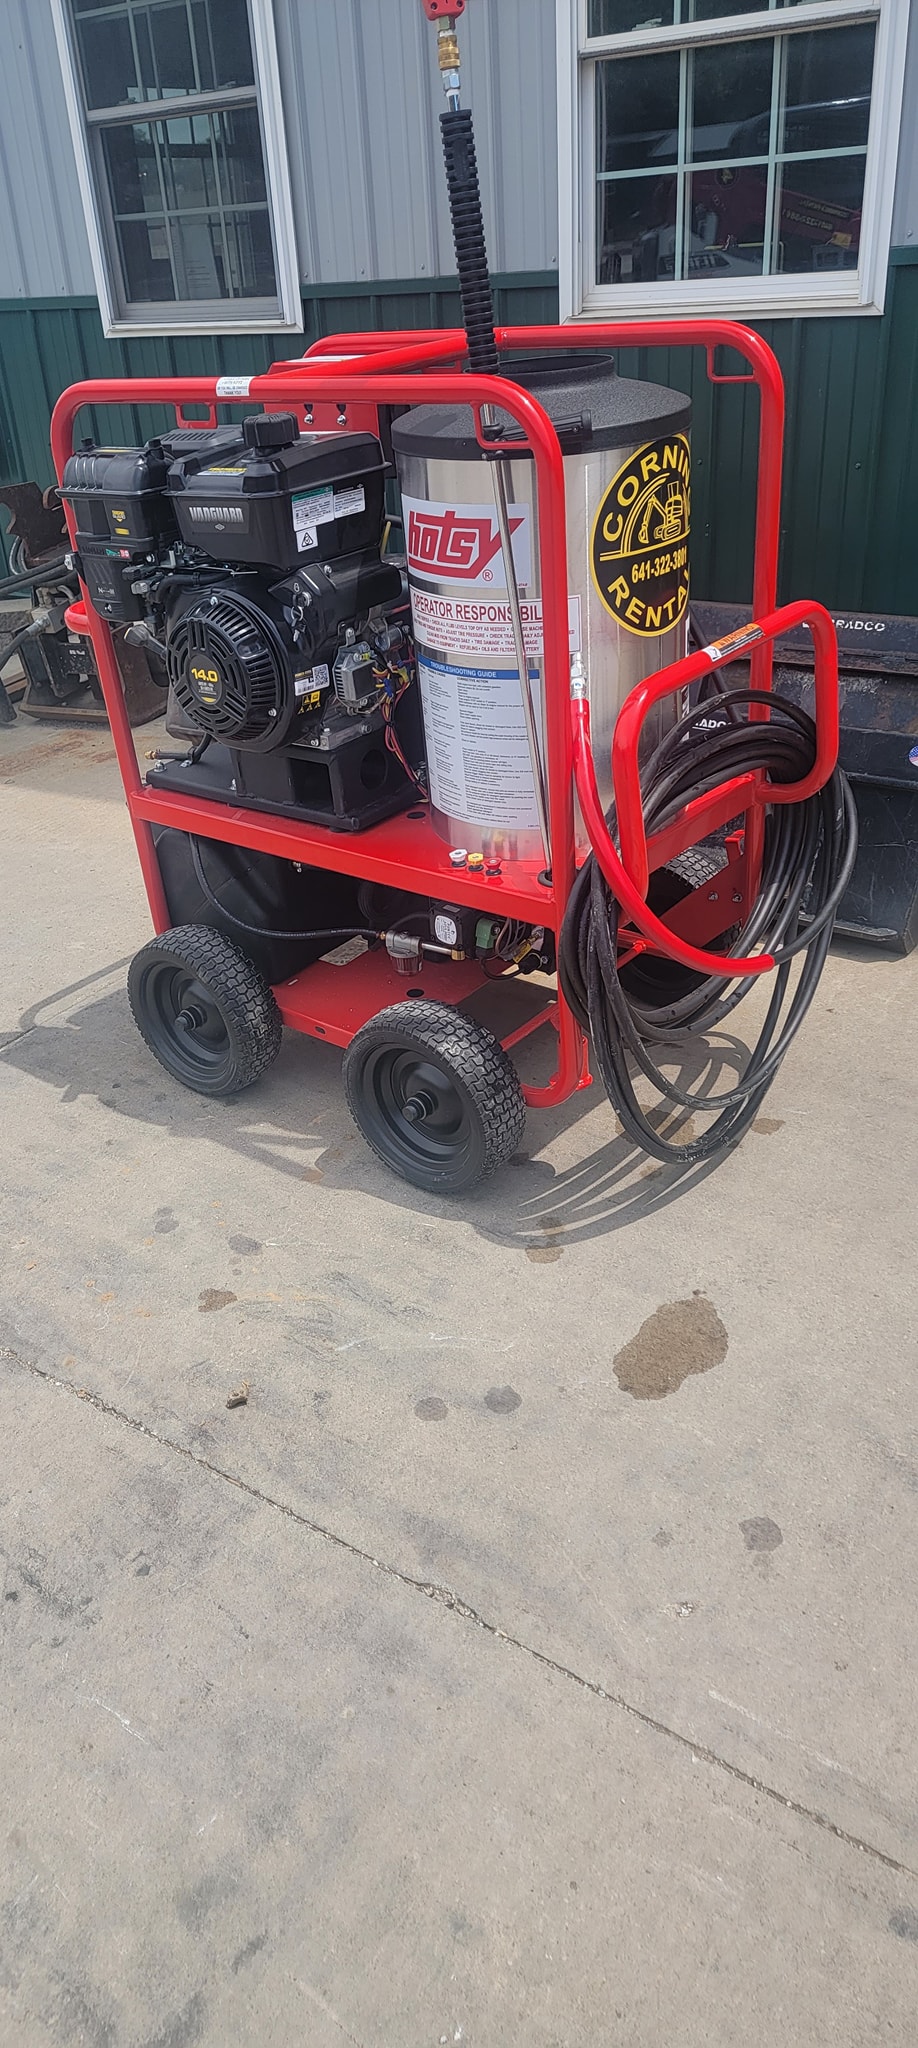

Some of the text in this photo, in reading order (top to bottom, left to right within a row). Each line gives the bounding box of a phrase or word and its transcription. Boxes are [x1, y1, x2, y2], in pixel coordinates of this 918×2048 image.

[603, 445, 690, 542] CORNIN
[189, 507, 244, 523] VANGUARD
[631, 545, 687, 583] 641-322-3801
[413, 592, 453, 619] OPERATOR
[191, 668, 218, 682] 14.0
[430, 661, 477, 677] TROUBLESHOOTING
[477, 669, 497, 678] GUIDE
